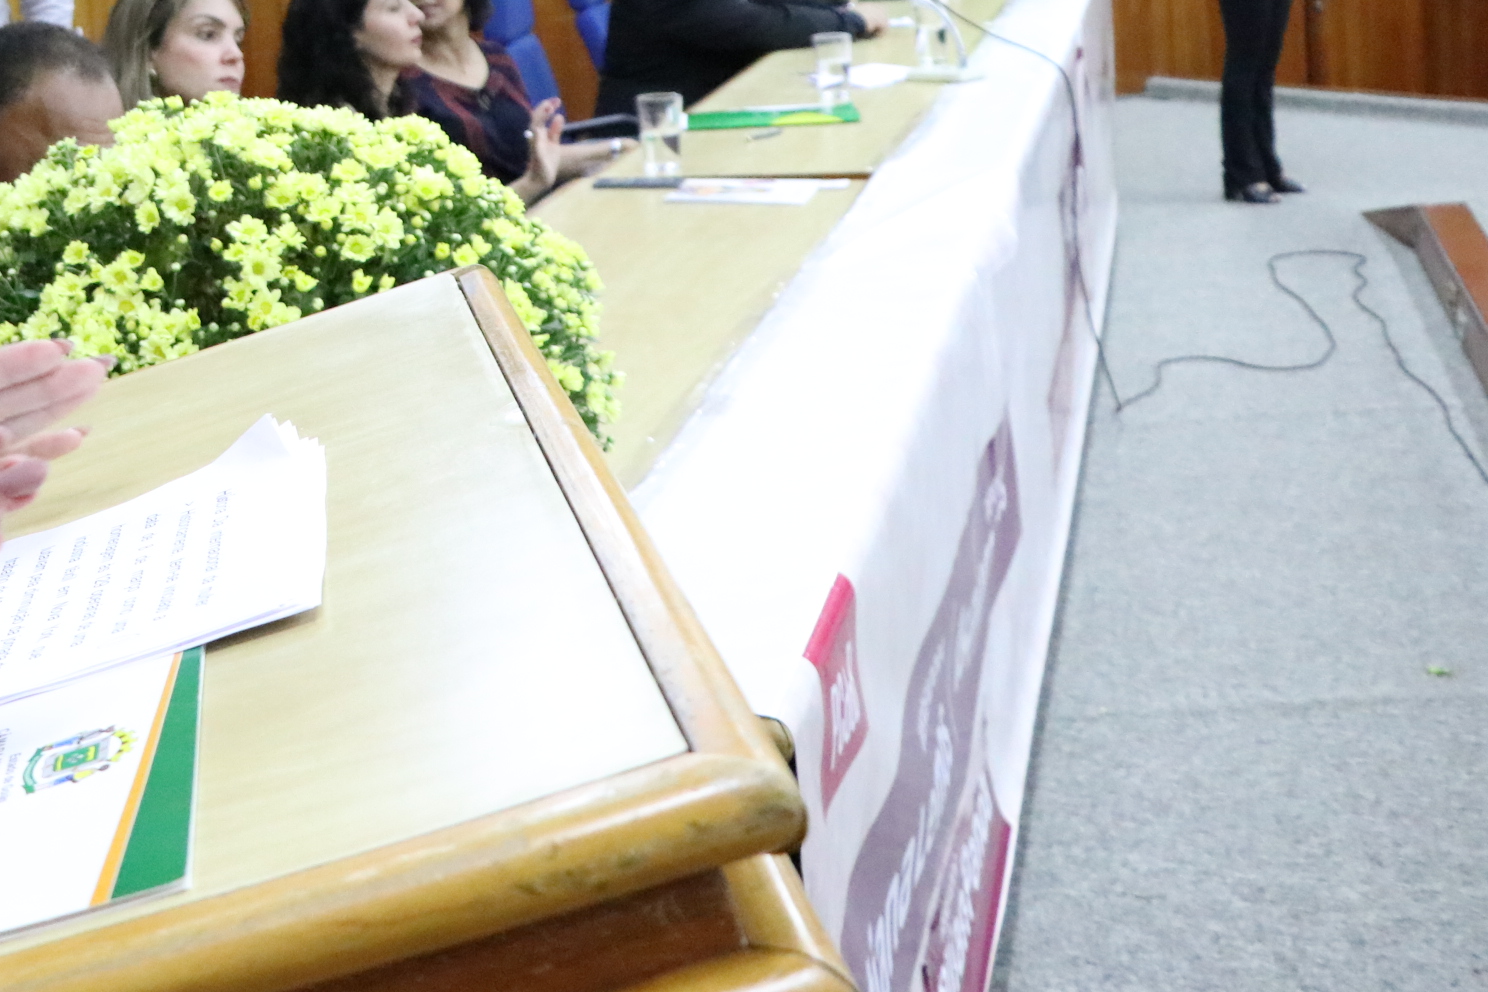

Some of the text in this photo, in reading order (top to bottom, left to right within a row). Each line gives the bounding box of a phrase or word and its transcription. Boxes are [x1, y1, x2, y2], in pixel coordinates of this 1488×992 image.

[144, 513, 160, 530] data
[211, 515, 230, 528] Da
[99, 523, 126, 563] homenagem
[140, 532, 155, 543] de
[68, 535, 89, 564] indústria
[134, 555, 148, 566] de
[26, 572, 43, 588] pela
[123, 569, 144, 593] março
[57, 585, 71, 599] em
[47, 601, 68, 622] Nova
[119, 596, 137, 616] como
[110, 621, 128, 635] uma
[69, 634, 86, 648] uma
